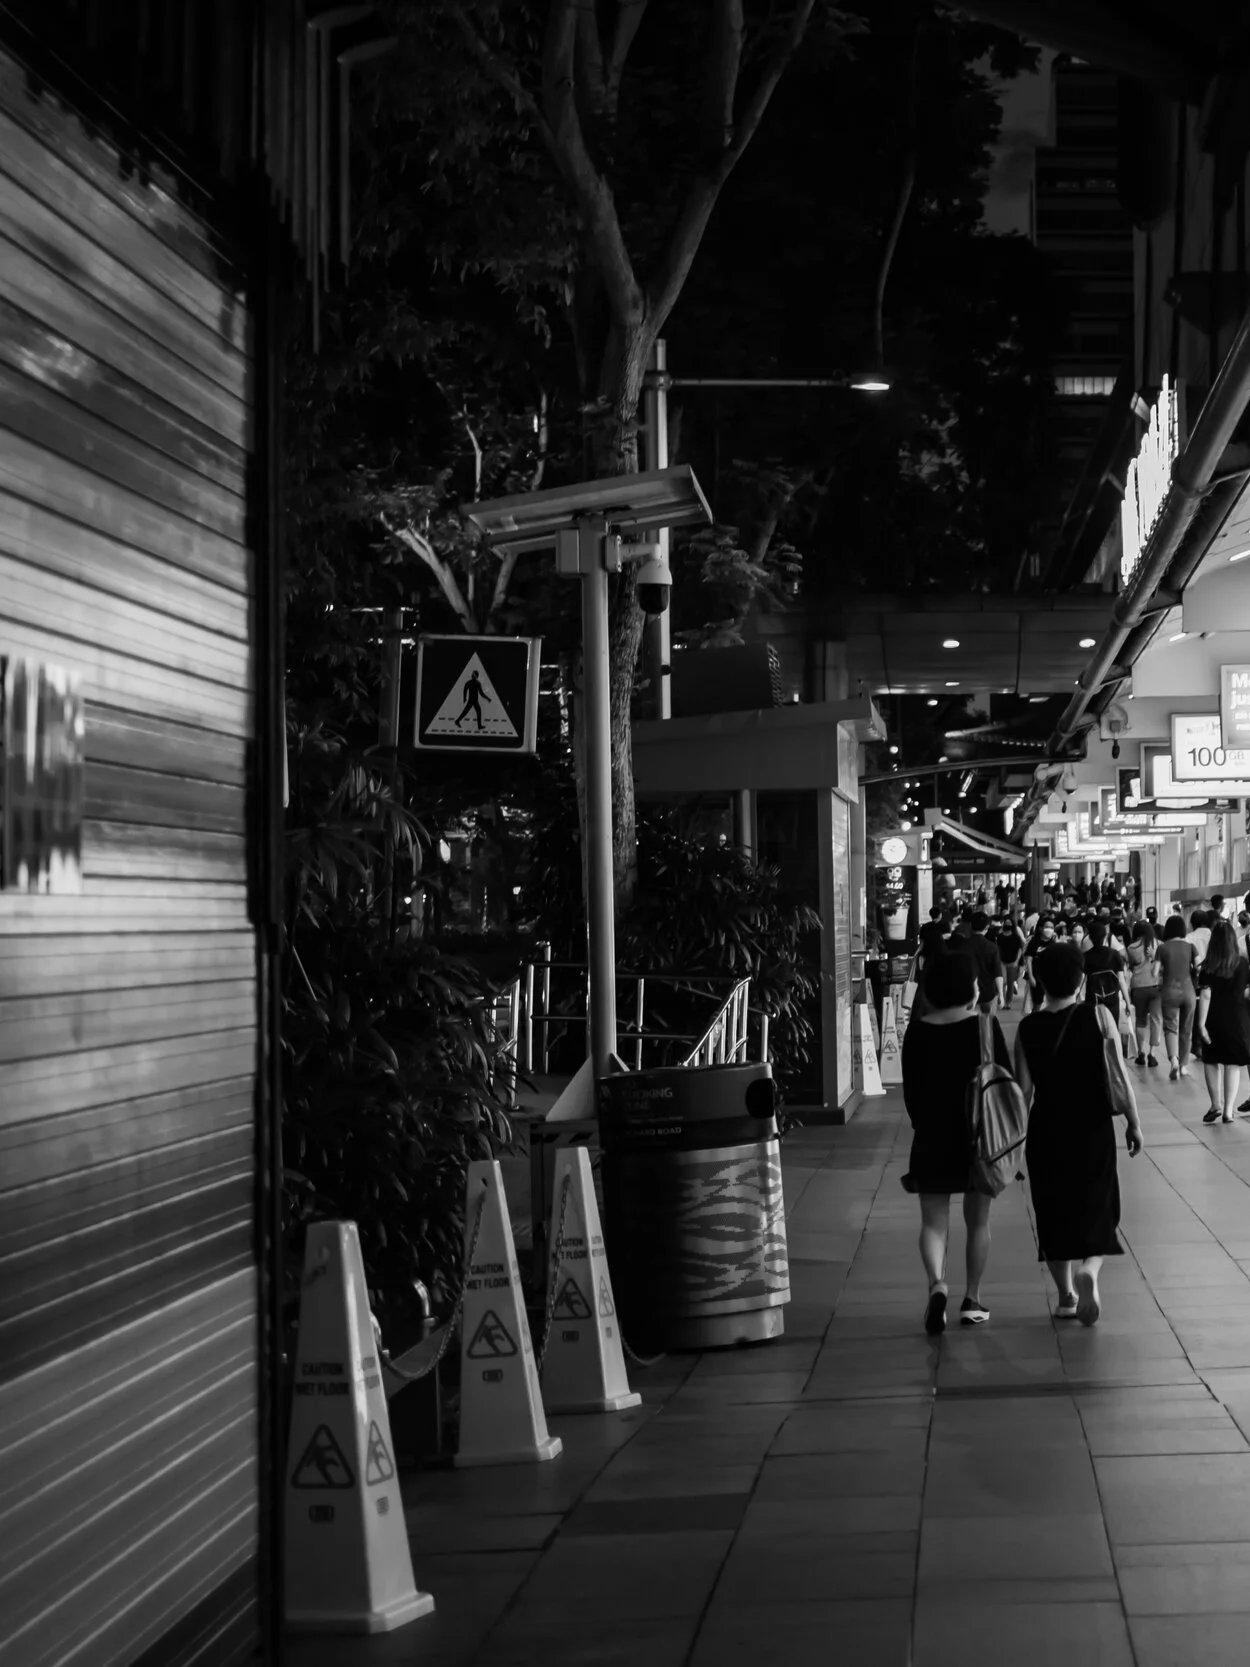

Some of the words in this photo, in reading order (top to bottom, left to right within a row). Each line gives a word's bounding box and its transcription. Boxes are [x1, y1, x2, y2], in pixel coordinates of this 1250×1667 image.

[1188, 747, 1226, 767] 100
[657, 1127, 682, 1136] ROAD
[471, 1263, 504, 1275] CAUTION
[484, 1277, 510, 1289] FLOOR
[302, 1362, 344, 1376] CAUTION
[295, 1382, 314, 1396] WET
[317, 1382, 349, 1396] FLOOR
